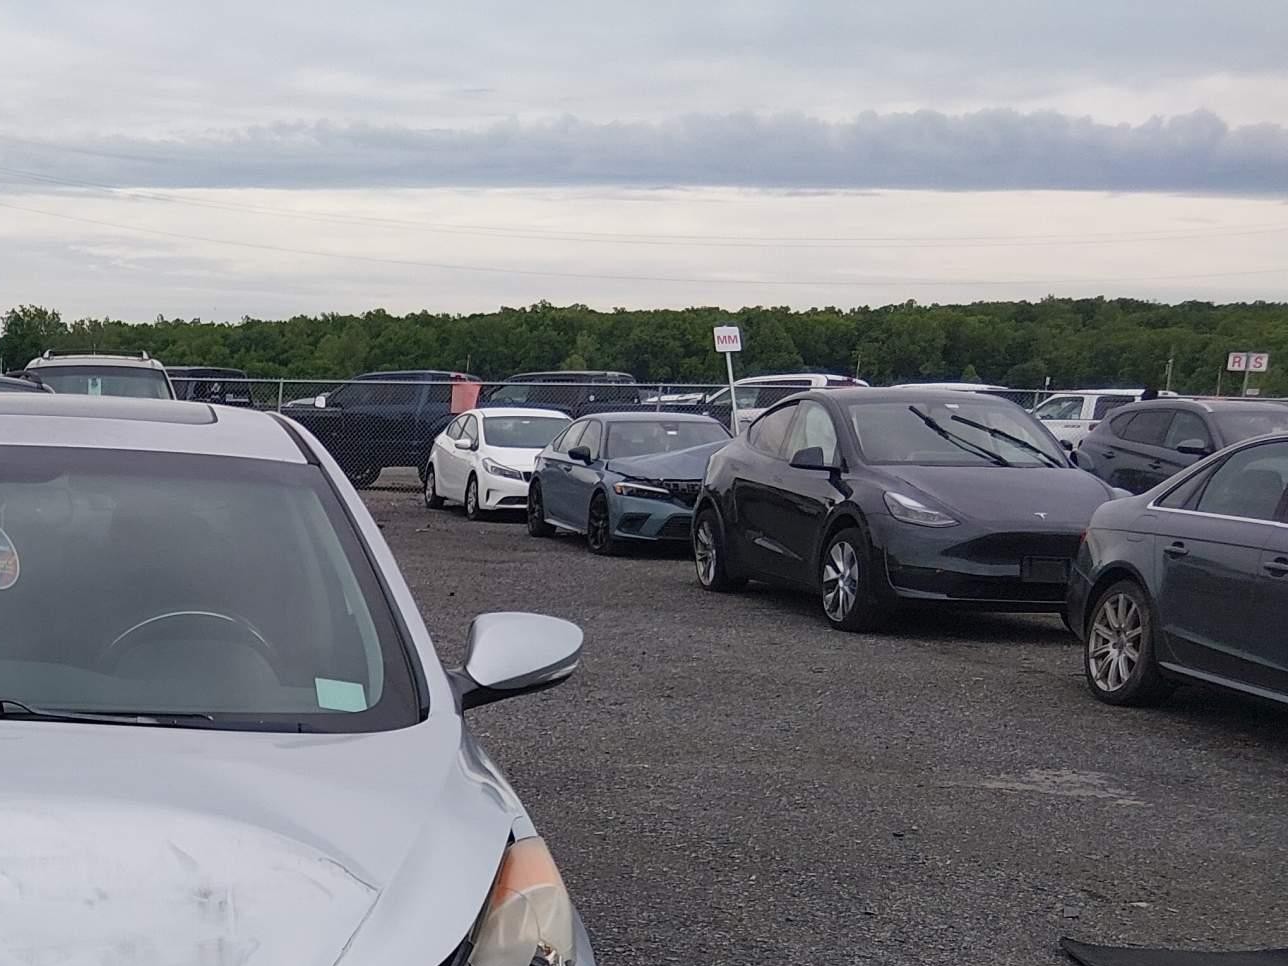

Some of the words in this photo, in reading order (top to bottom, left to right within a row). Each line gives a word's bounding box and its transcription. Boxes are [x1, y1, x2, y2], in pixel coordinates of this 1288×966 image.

[716, 335, 739, 345] MM
[1232, 355, 1242, 368] R
[1253, 355, 1264, 368] S
